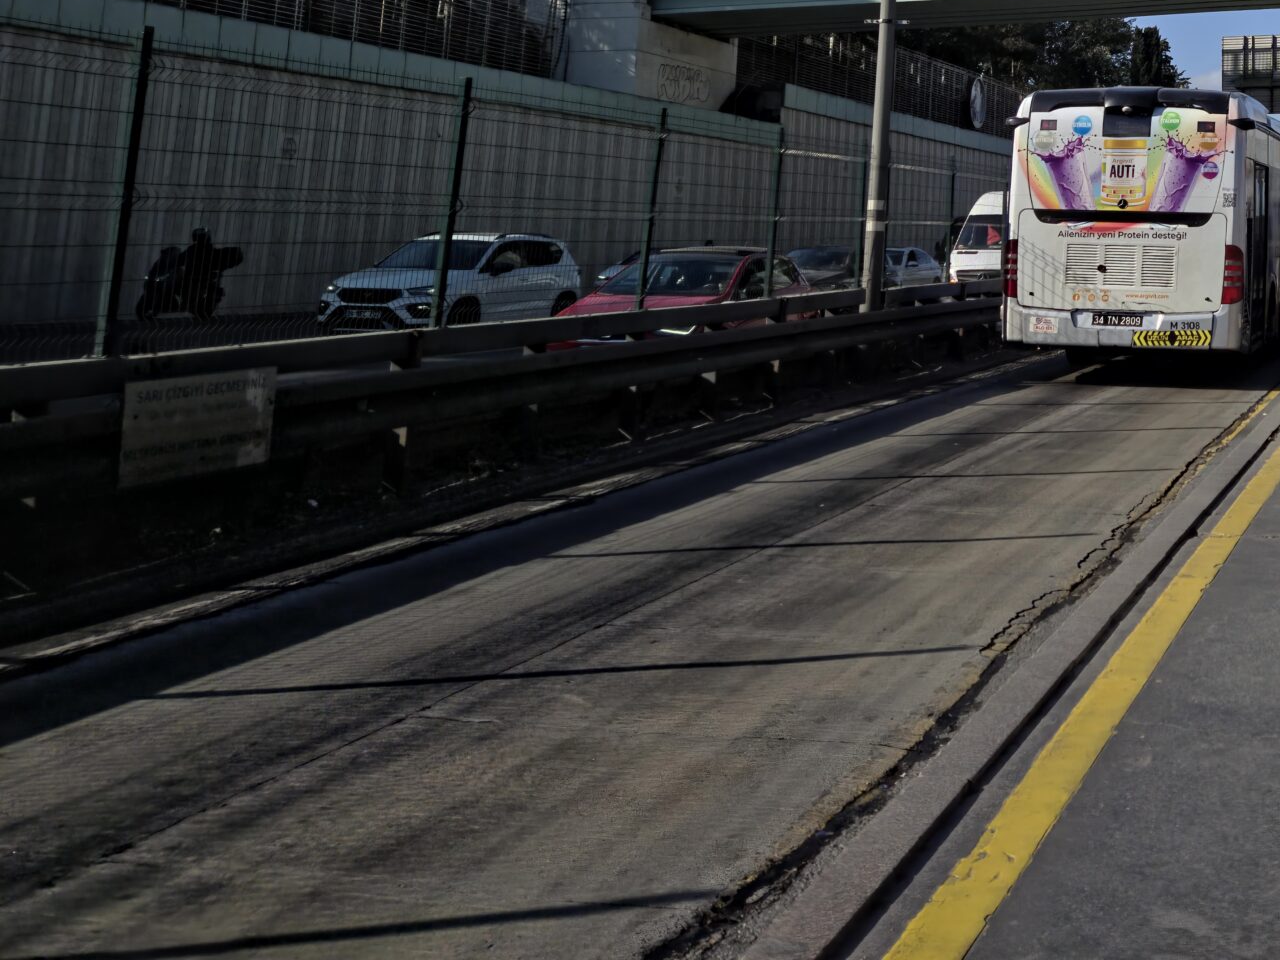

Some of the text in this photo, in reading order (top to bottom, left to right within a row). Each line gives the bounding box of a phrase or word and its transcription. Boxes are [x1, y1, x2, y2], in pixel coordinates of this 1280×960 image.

[1058, 230, 1187, 240] Ailenizin yeni Protein desteği!
[1093, 315, 1141, 326] 34 TN 2809
[1170, 321, 1200, 330] M 3108
[136, 389, 162, 404] SARI
